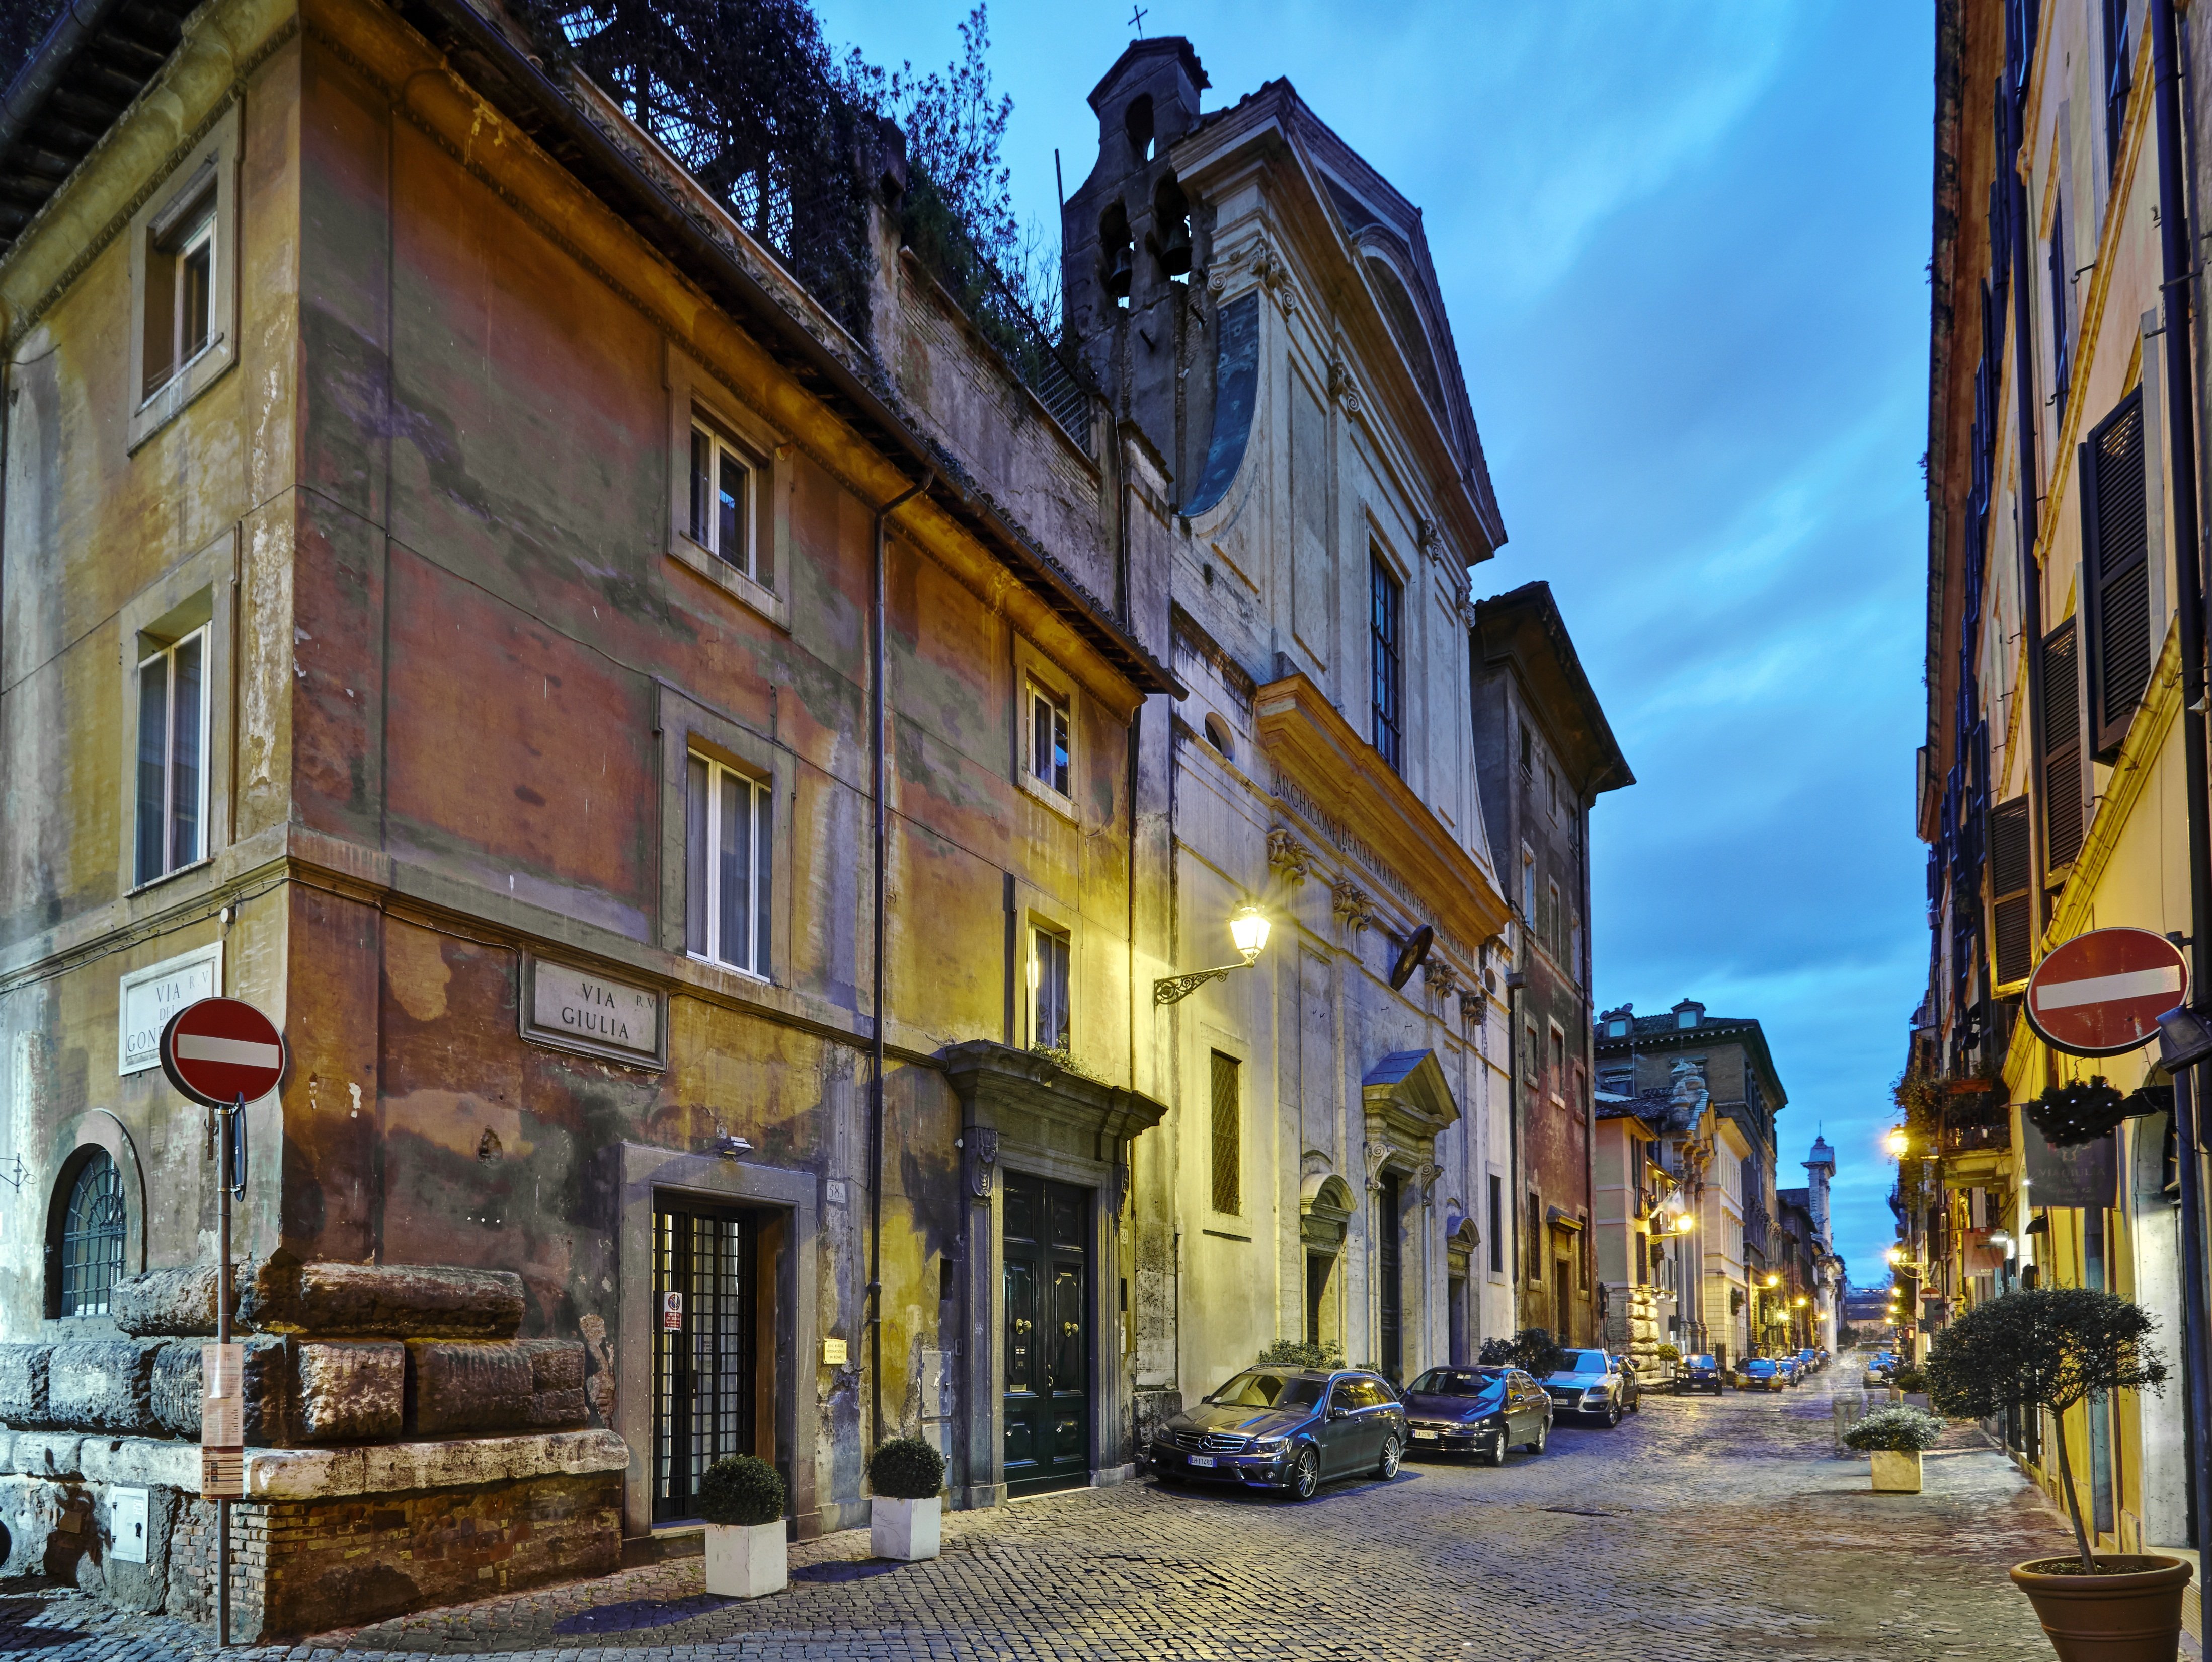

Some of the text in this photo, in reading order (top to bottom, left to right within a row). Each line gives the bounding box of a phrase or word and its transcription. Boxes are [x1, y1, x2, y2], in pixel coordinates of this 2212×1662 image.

[156, 982, 180, 1002] VIA
[582, 983, 615, 1008] VIA
[562, 1007, 629, 1039] GIULIA
